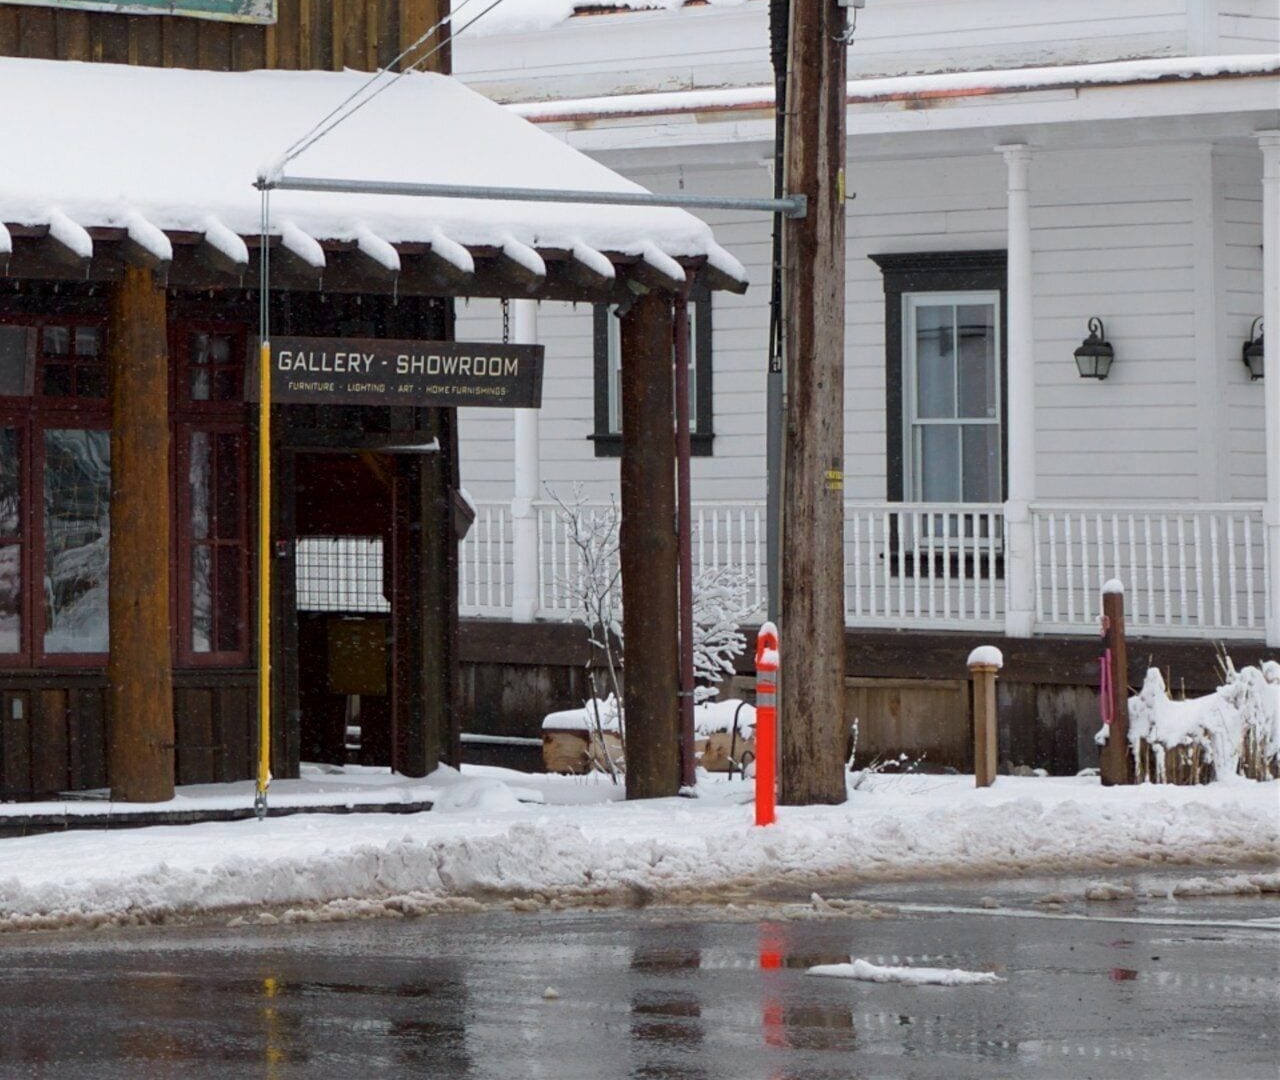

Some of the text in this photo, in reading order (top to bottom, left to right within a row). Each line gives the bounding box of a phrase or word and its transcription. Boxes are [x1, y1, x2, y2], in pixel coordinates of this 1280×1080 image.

[277, 351, 375, 373] GALLERY
[395, 354, 519, 377] SHOWROOM
[288, 382, 507, 395] FURNITURE LIGHTING ART HOME FURNISHINGS
